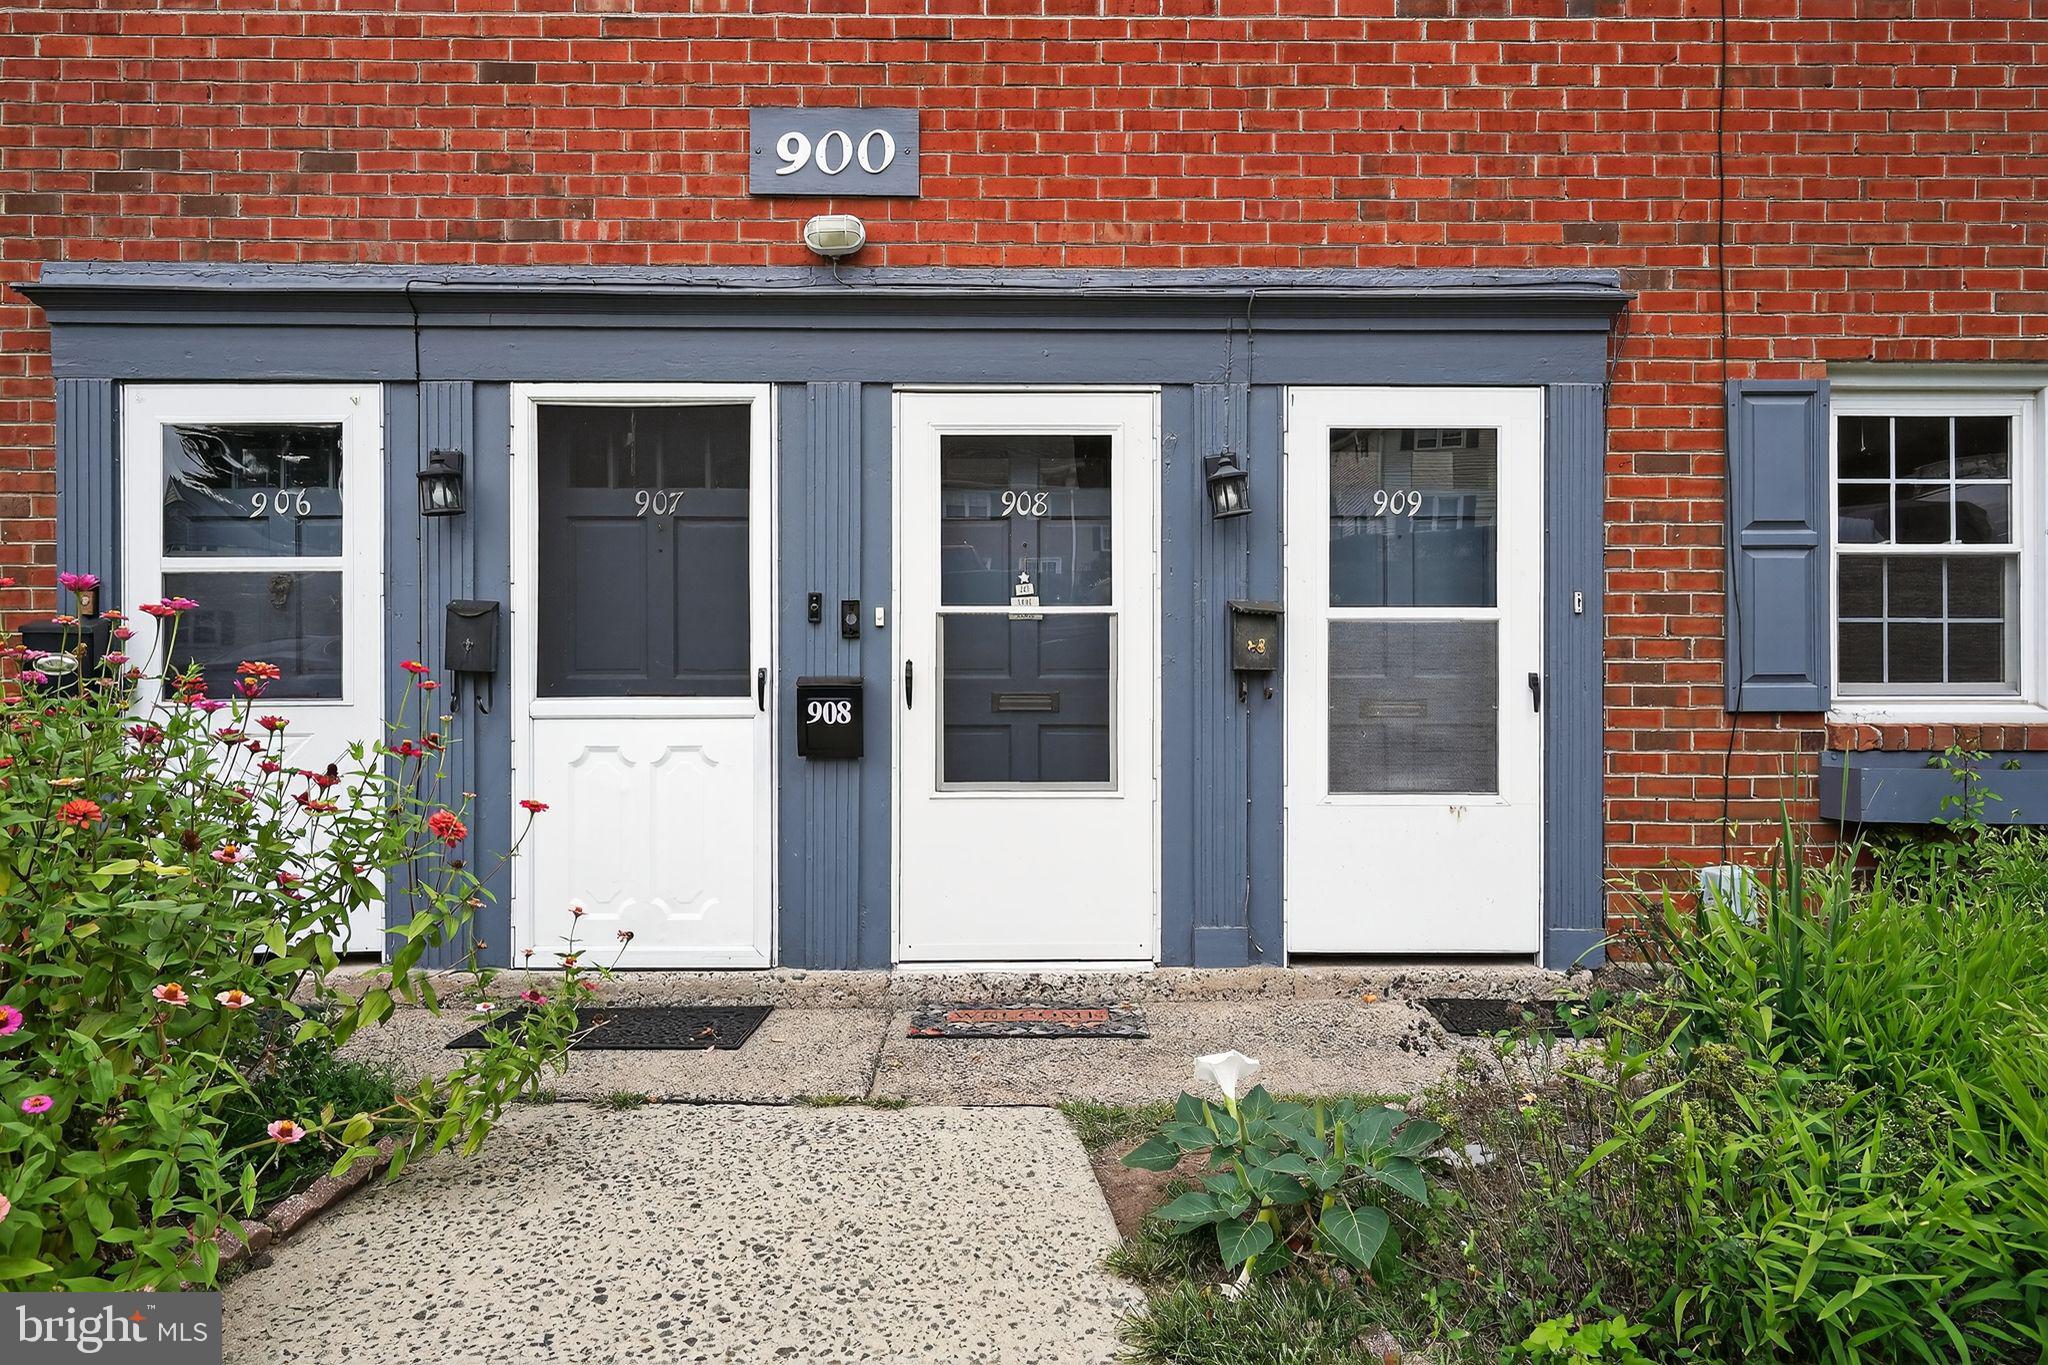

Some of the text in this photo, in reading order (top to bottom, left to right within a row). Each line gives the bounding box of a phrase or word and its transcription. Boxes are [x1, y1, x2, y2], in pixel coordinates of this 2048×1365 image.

[775, 129, 896, 175] 900
[249, 488, 311, 518] 906
[635, 489, 684, 517] 907
[1001, 490, 1049, 517] 908
[1373, 489, 1422, 517] 909
[806, 700, 852, 725] 908
